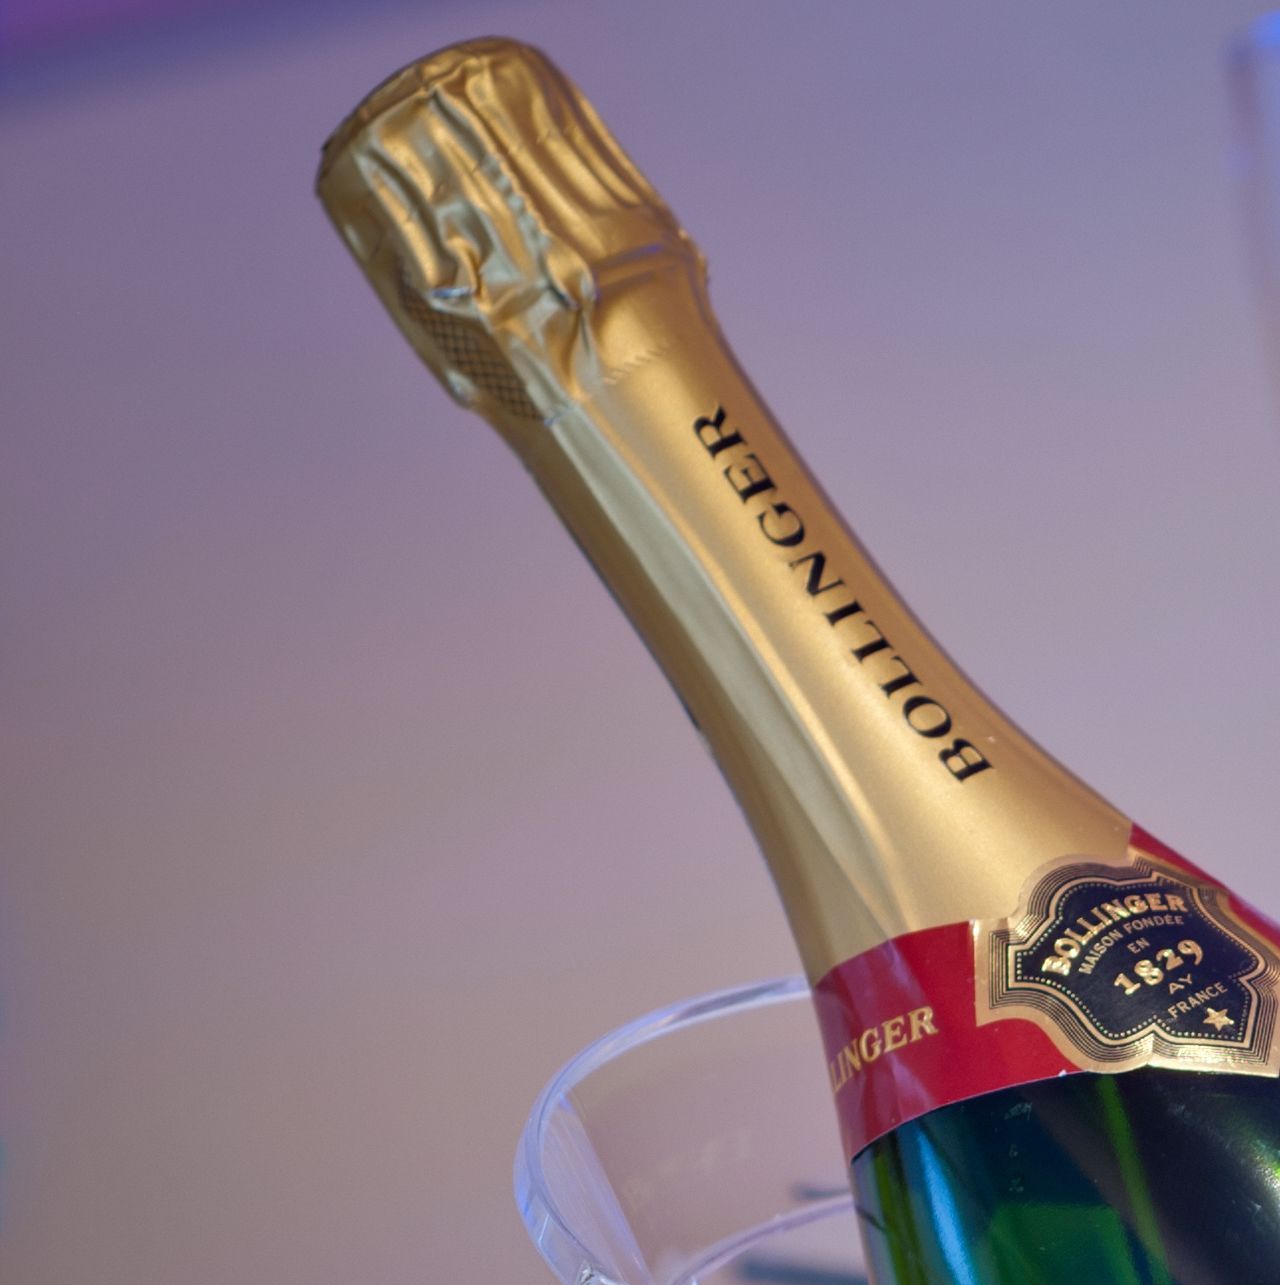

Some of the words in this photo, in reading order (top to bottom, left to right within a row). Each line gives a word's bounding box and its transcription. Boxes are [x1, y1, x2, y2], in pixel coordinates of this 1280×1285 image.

[691, 400, 994, 784] BOLLINGER
[1041, 892, 1188, 976] BOLLINGER
[1078, 929, 1124, 975] MAISON
[1127, 937, 1150, 954] EN
[1114, 939, 1204, 996] 1829
[1168, 973, 1193, 995] AY
[1167, 981, 1228, 1020] FRANCE
